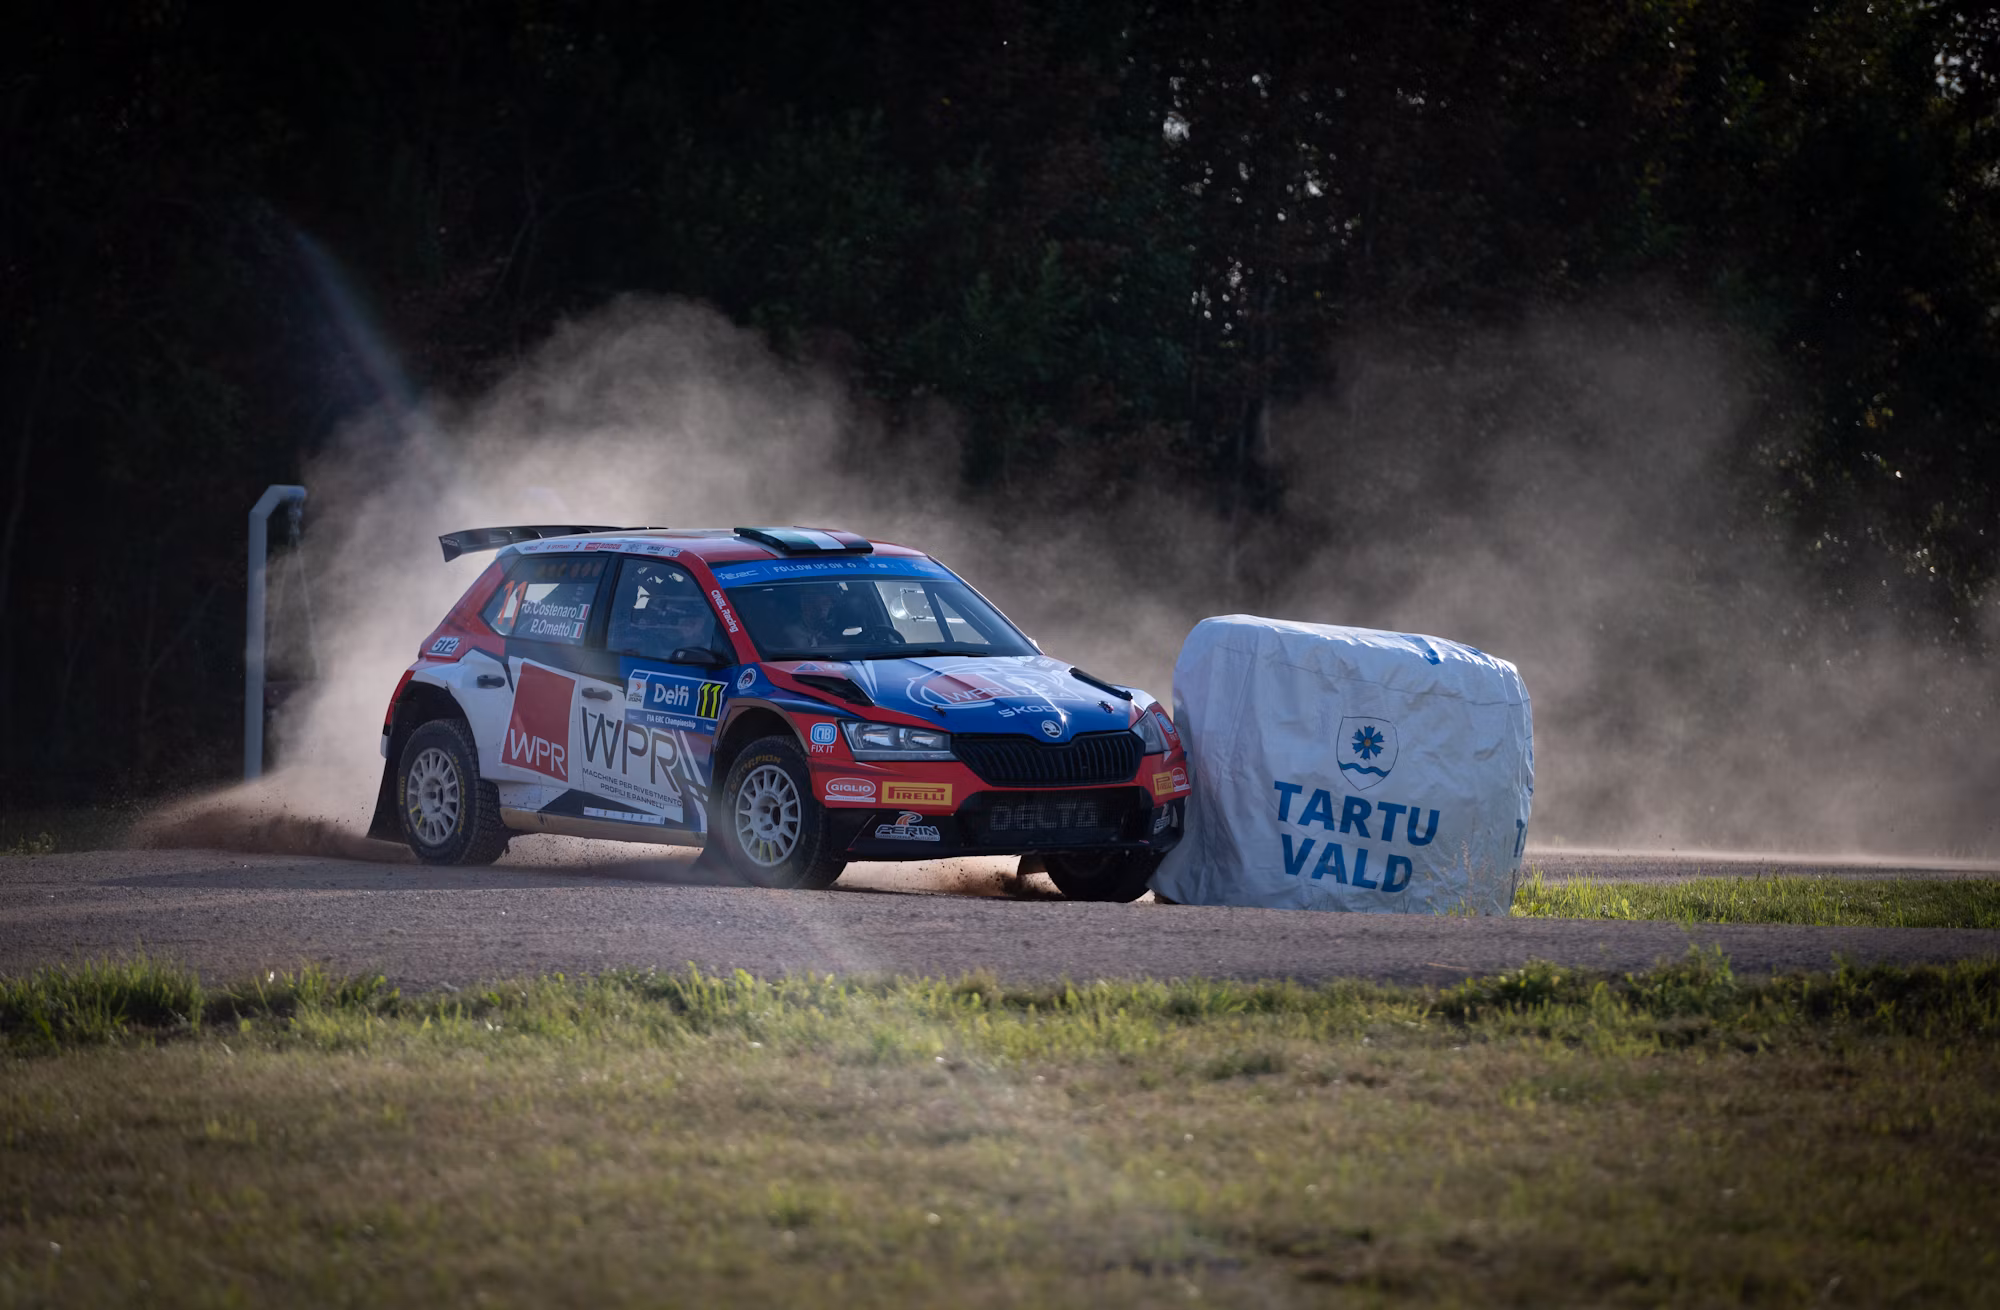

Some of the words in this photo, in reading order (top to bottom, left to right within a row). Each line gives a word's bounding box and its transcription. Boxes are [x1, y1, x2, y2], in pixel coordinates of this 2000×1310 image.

[773, 564, 812, 573] FOLLOW
[497, 580, 528, 627] 11
[530, 619, 571, 637] P.Ometto
[721, 608, 739, 633] Racing
[653, 683, 689, 707] Delfi
[701, 683, 722, 718] 11
[943, 687, 1008, 702] WPR
[646, 713, 655, 722] FIA
[655, 715, 665, 724] ERC
[665, 716, 696, 729] Championship
[510, 729, 567, 776] WPR
[582, 706, 680, 793] WPR
[811, 744, 824, 753] FIX
[826, 745, 835, 753] IT
[583, 768, 618, 785] MACCHINE
[619, 780, 632, 790] PER
[831, 784, 871, 793] GIGLIO
[600, 783, 626, 796] PROFILI
[632, 793, 665, 810] PANNELLI
[888, 786, 945, 801] PIRELLI
[991, 803, 1098, 831] DELTA
[1274, 781, 1440, 846] TARTU
[876, 826, 939, 836] PERIN
[1281, 834, 1413, 893] VALD
